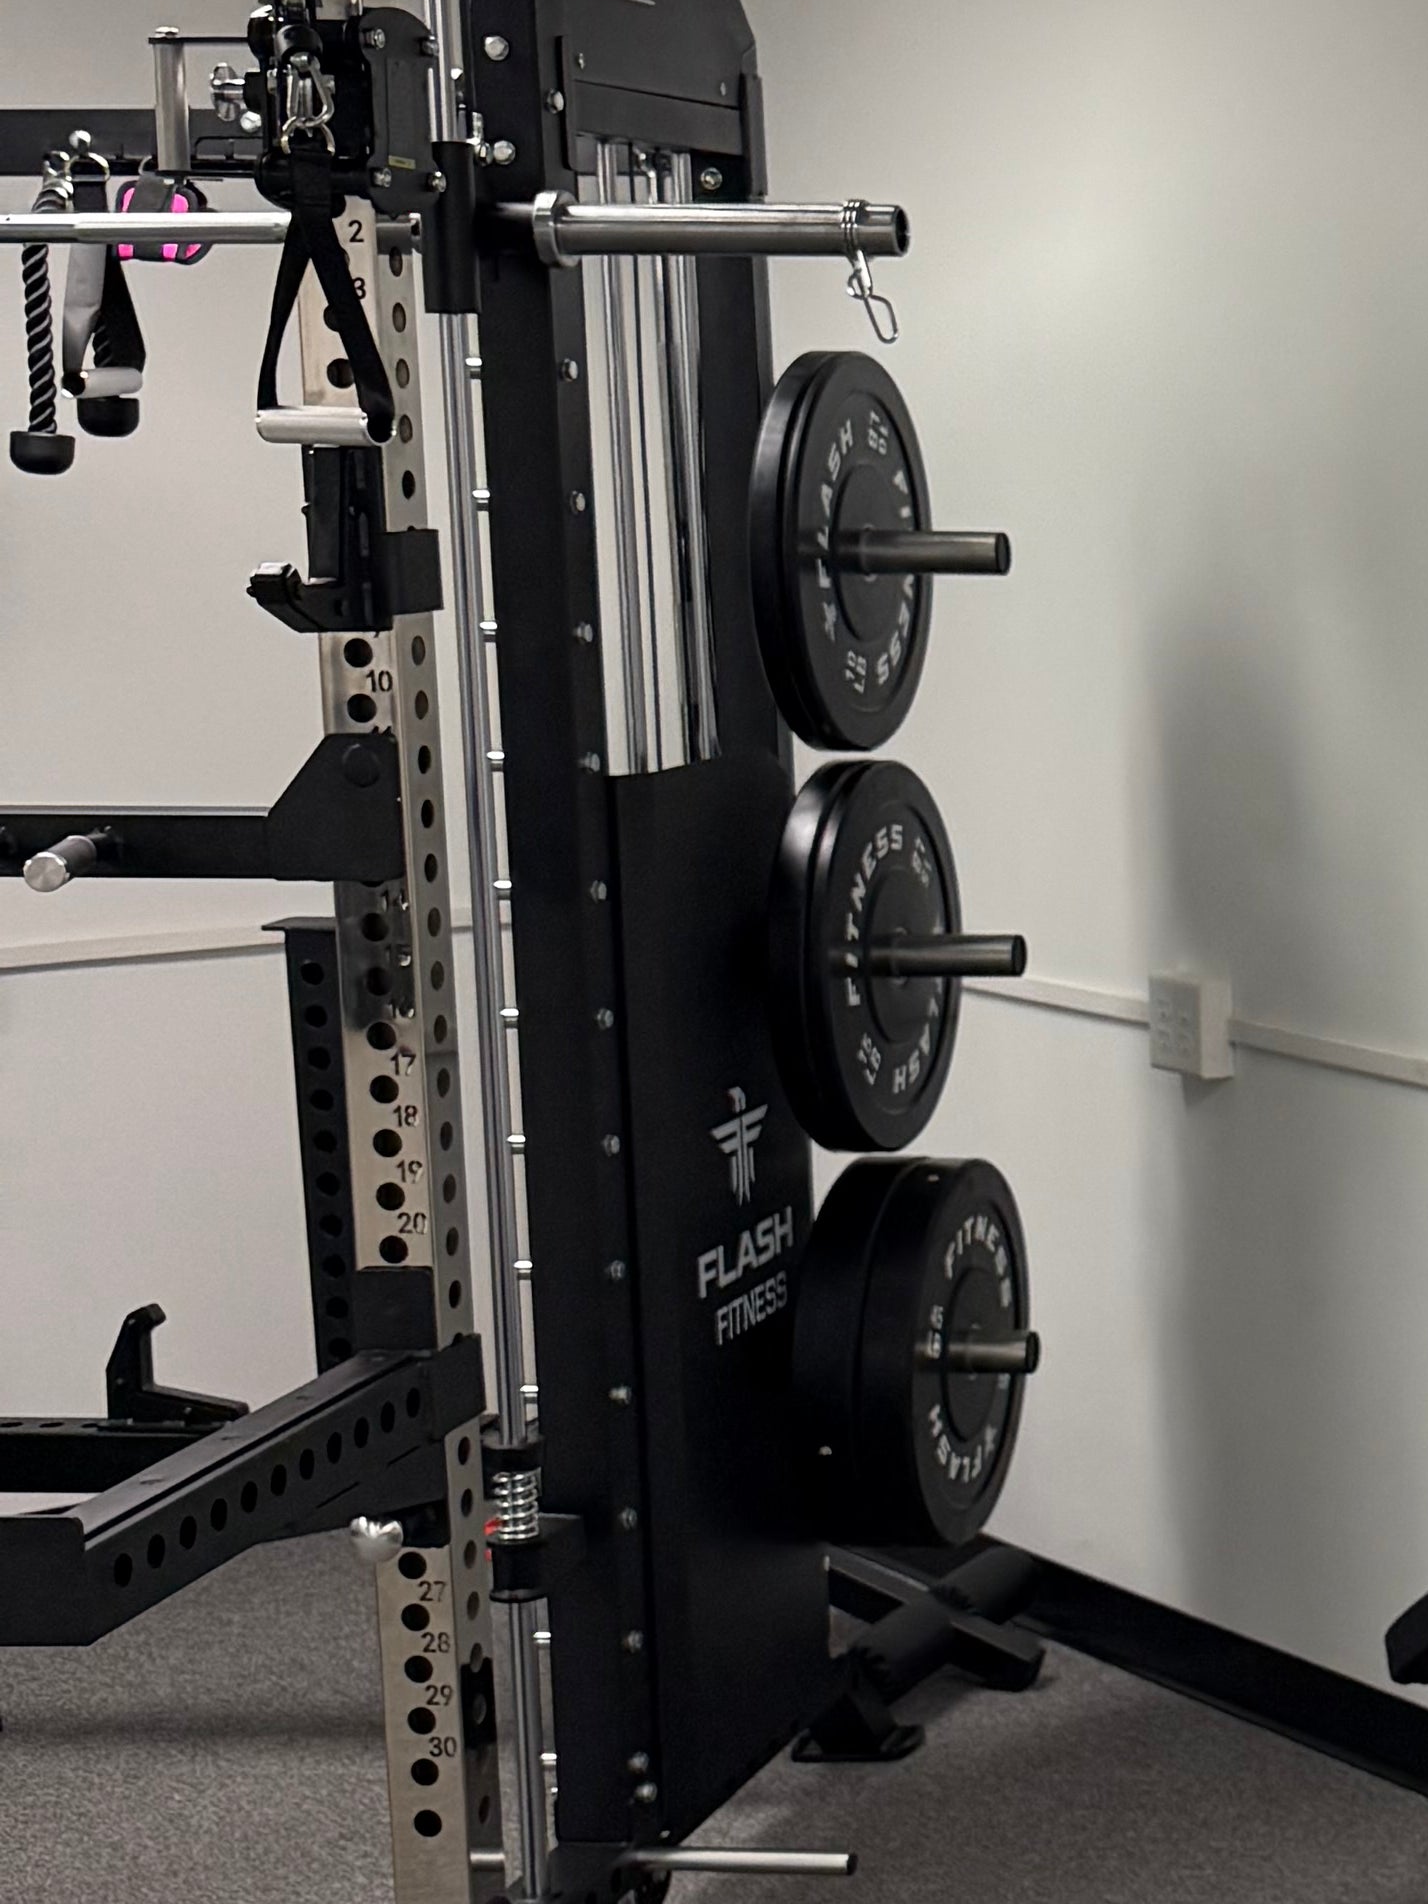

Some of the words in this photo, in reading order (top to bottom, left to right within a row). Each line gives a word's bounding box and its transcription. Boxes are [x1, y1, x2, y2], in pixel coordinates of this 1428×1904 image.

[348, 219, 364, 243] 2
[815, 418, 854, 589] FLASH
[366, 669, 393, 693] 10
[844, 824, 903, 1007] FITNESS
[390, 1049, 416, 1076] 17
[392, 1104, 419, 1127] 18
[396, 1159, 423, 1184] 19
[397, 1212, 428, 1235] 20
[697, 1205, 793, 1299] FLASH
[715, 1270, 788, 1346] FITNESS
[418, 1580, 447, 1603] 27
[420, 1632, 450, 1653] 28
[425, 1684, 453, 1706] 29
[428, 1736, 457, 1757] 30
